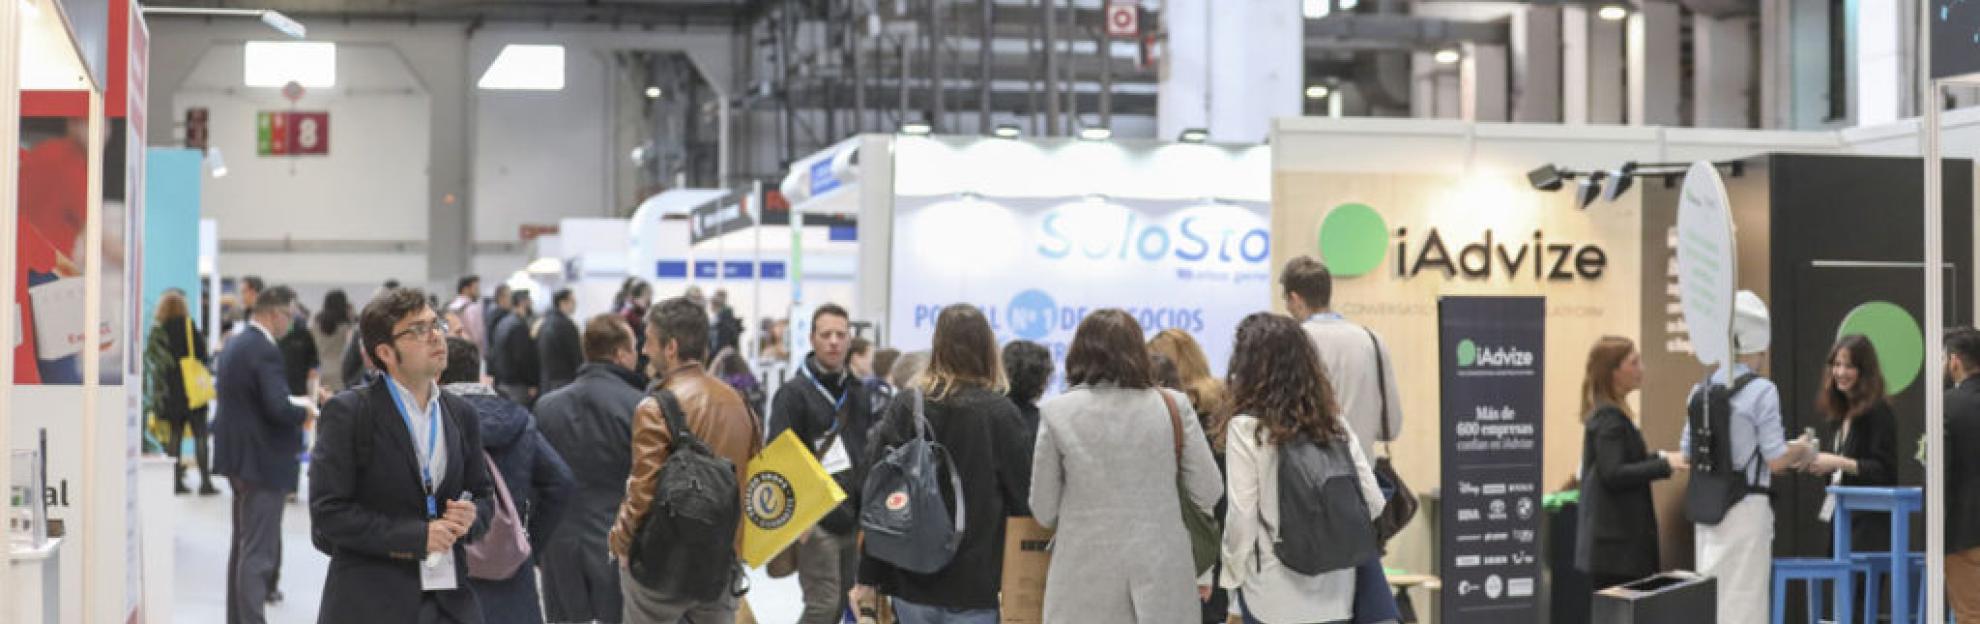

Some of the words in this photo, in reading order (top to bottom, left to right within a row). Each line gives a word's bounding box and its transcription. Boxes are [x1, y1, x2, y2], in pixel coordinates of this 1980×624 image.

[299, 117, 317, 148] 8
[1396, 228, 1607, 280] iAdvize
[1129, 307, 1204, 331] OCIOS
[1477, 346, 1534, 366] iAdvize
